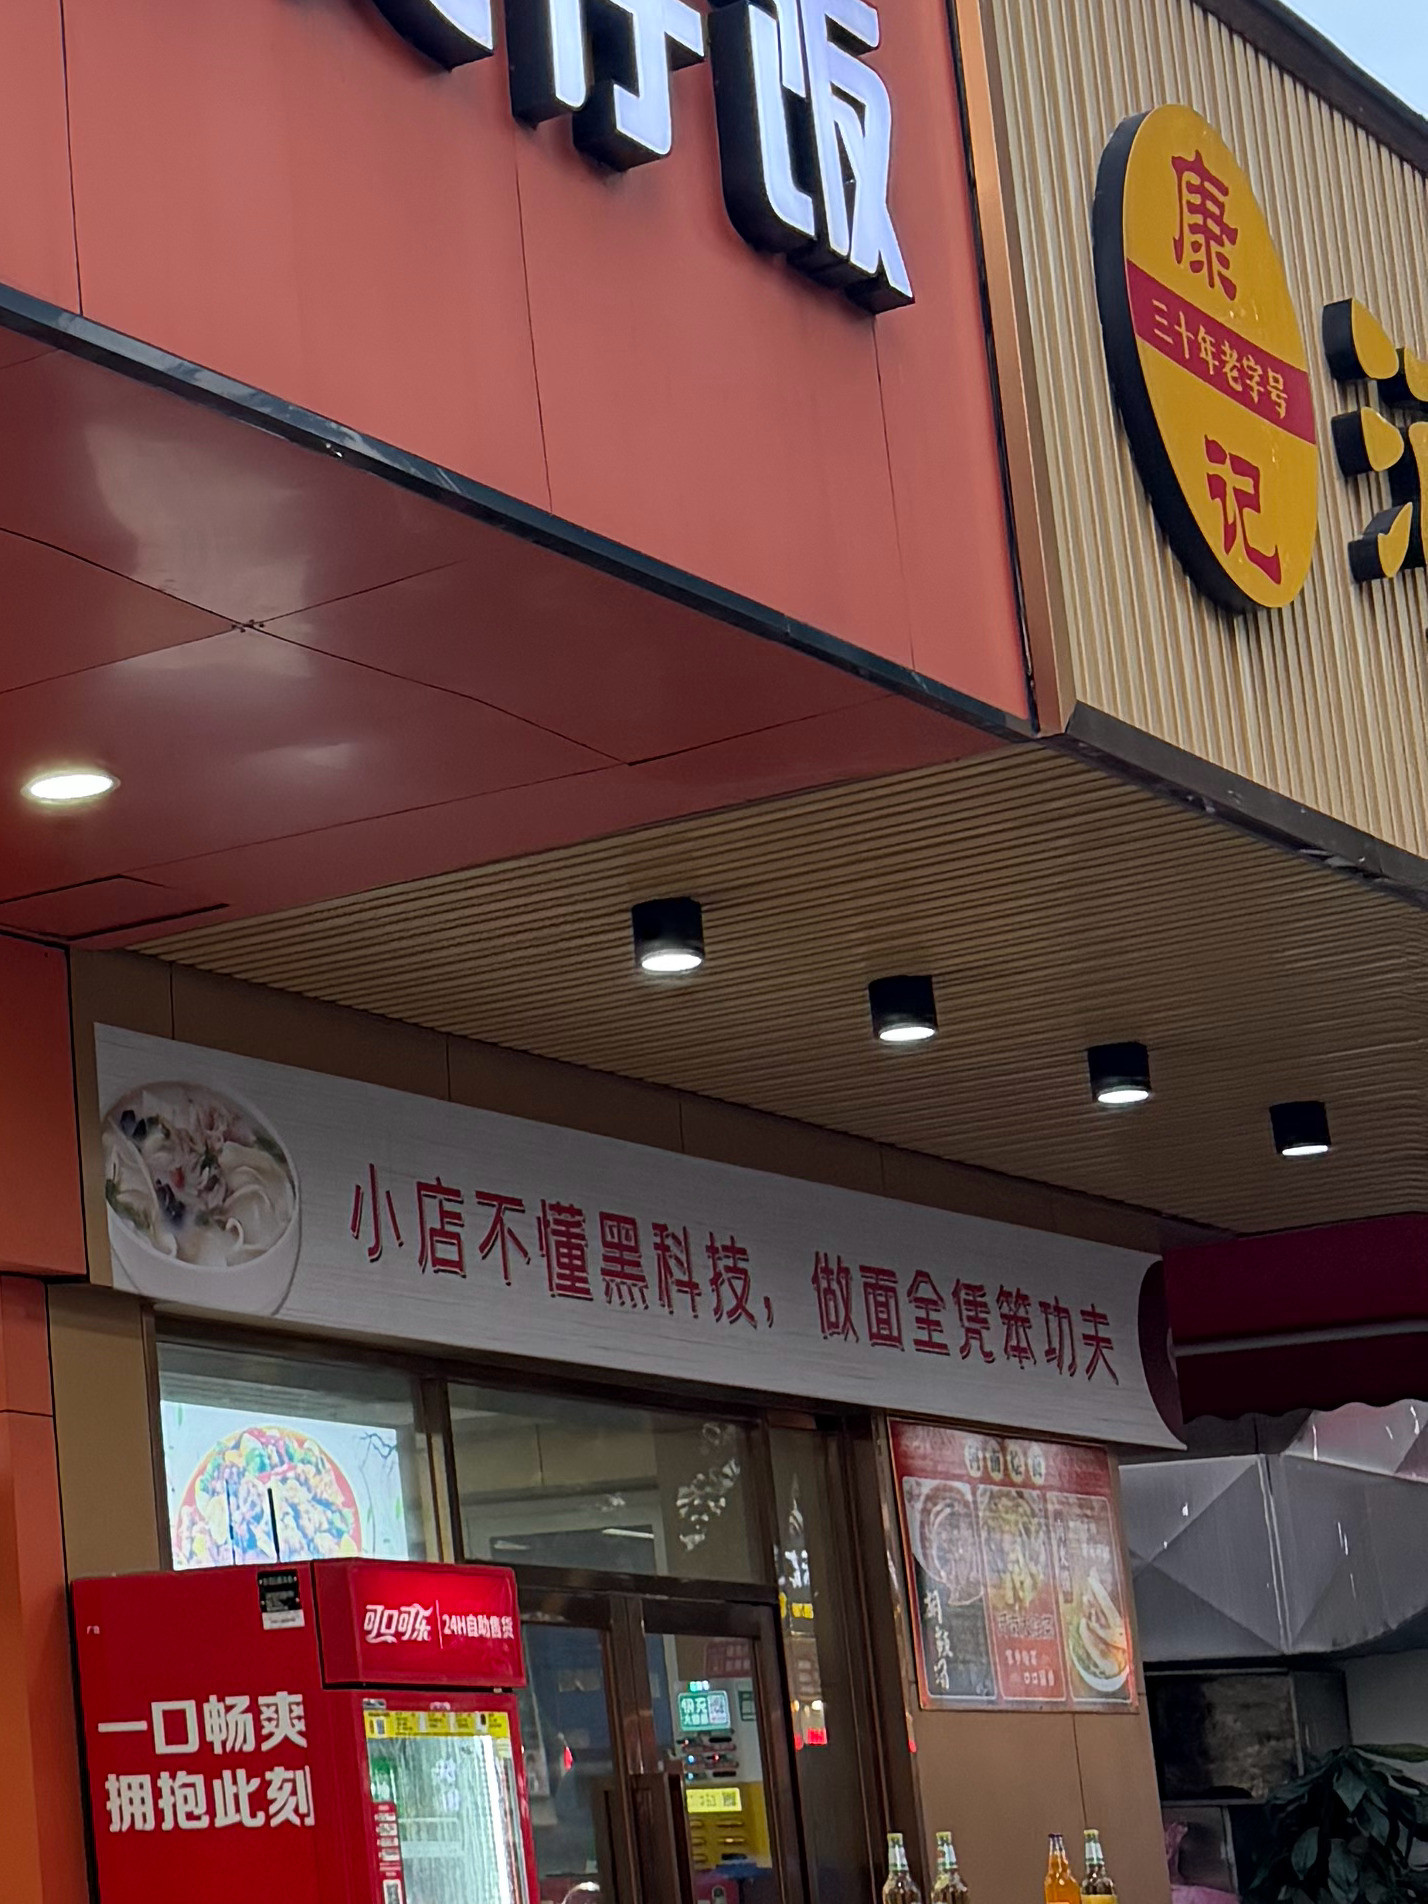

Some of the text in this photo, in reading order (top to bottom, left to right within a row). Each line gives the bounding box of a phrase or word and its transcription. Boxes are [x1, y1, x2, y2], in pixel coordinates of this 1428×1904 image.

[1171, 149, 1238, 302] 康
[1151, 297, 1289, 419] 三十年老字号
[1204, 434, 1282, 586] 记
[363, 1603, 434, 1644] 可口可乐
[97, 1690, 308, 1755] 一口畅爽
[104, 1764, 316, 1833] 拥抱此刻
